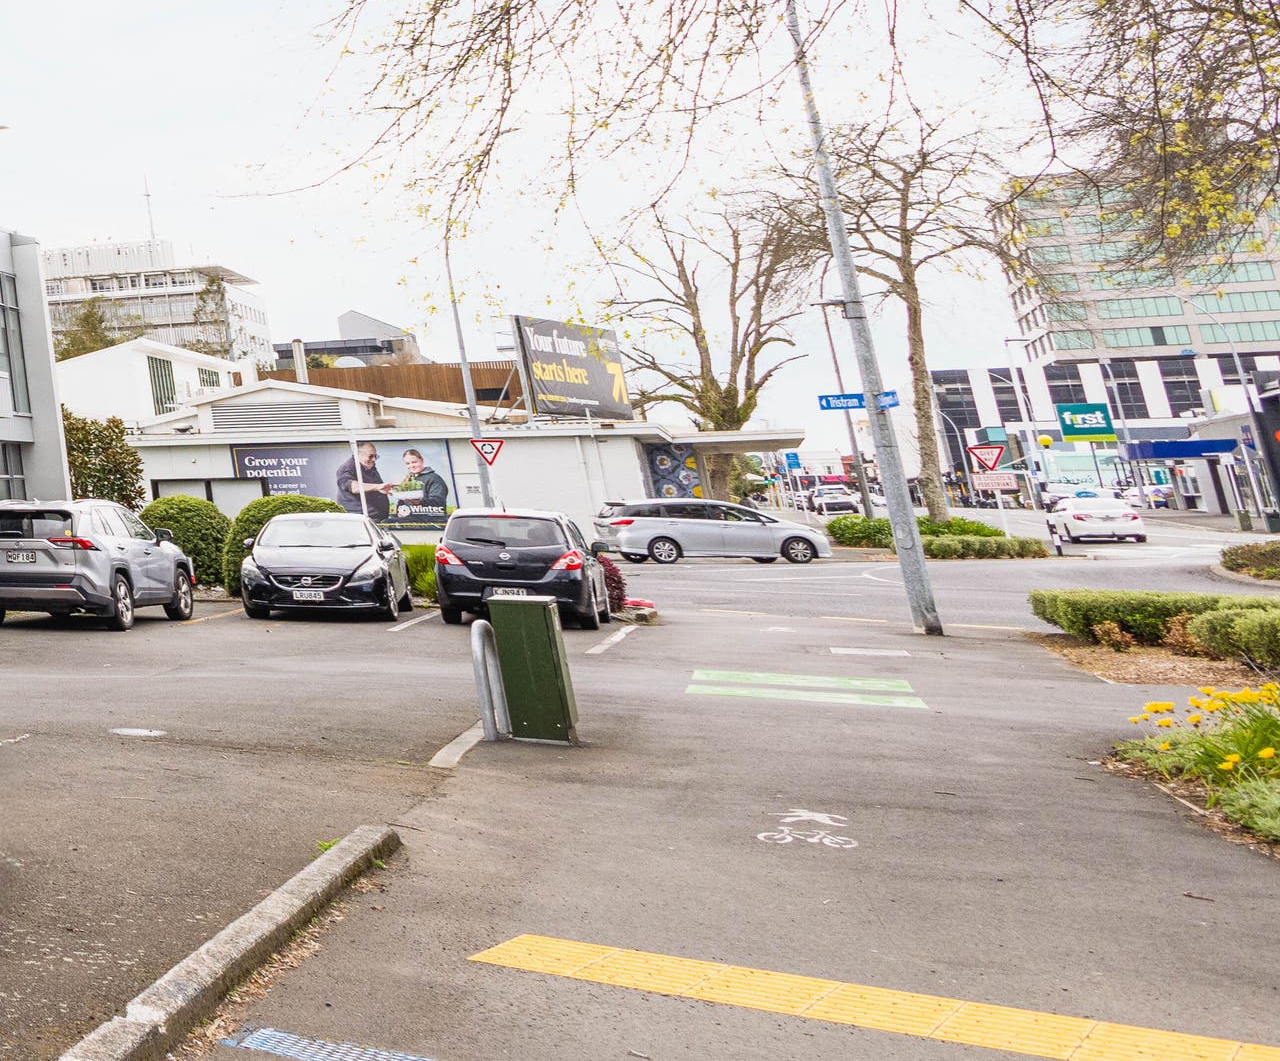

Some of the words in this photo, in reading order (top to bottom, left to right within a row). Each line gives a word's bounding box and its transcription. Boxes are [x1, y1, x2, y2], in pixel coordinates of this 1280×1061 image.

[524, 326, 553, 353] Your
[532, 361, 565, 382] starts
[562, 358, 589, 385] here
[828, 397, 860, 407] Tristram
[244, 456, 278, 466] Grow
[279, 457, 309, 468] your
[246, 467, 301, 478] potential
[410, 505, 445, 513] Wintec
